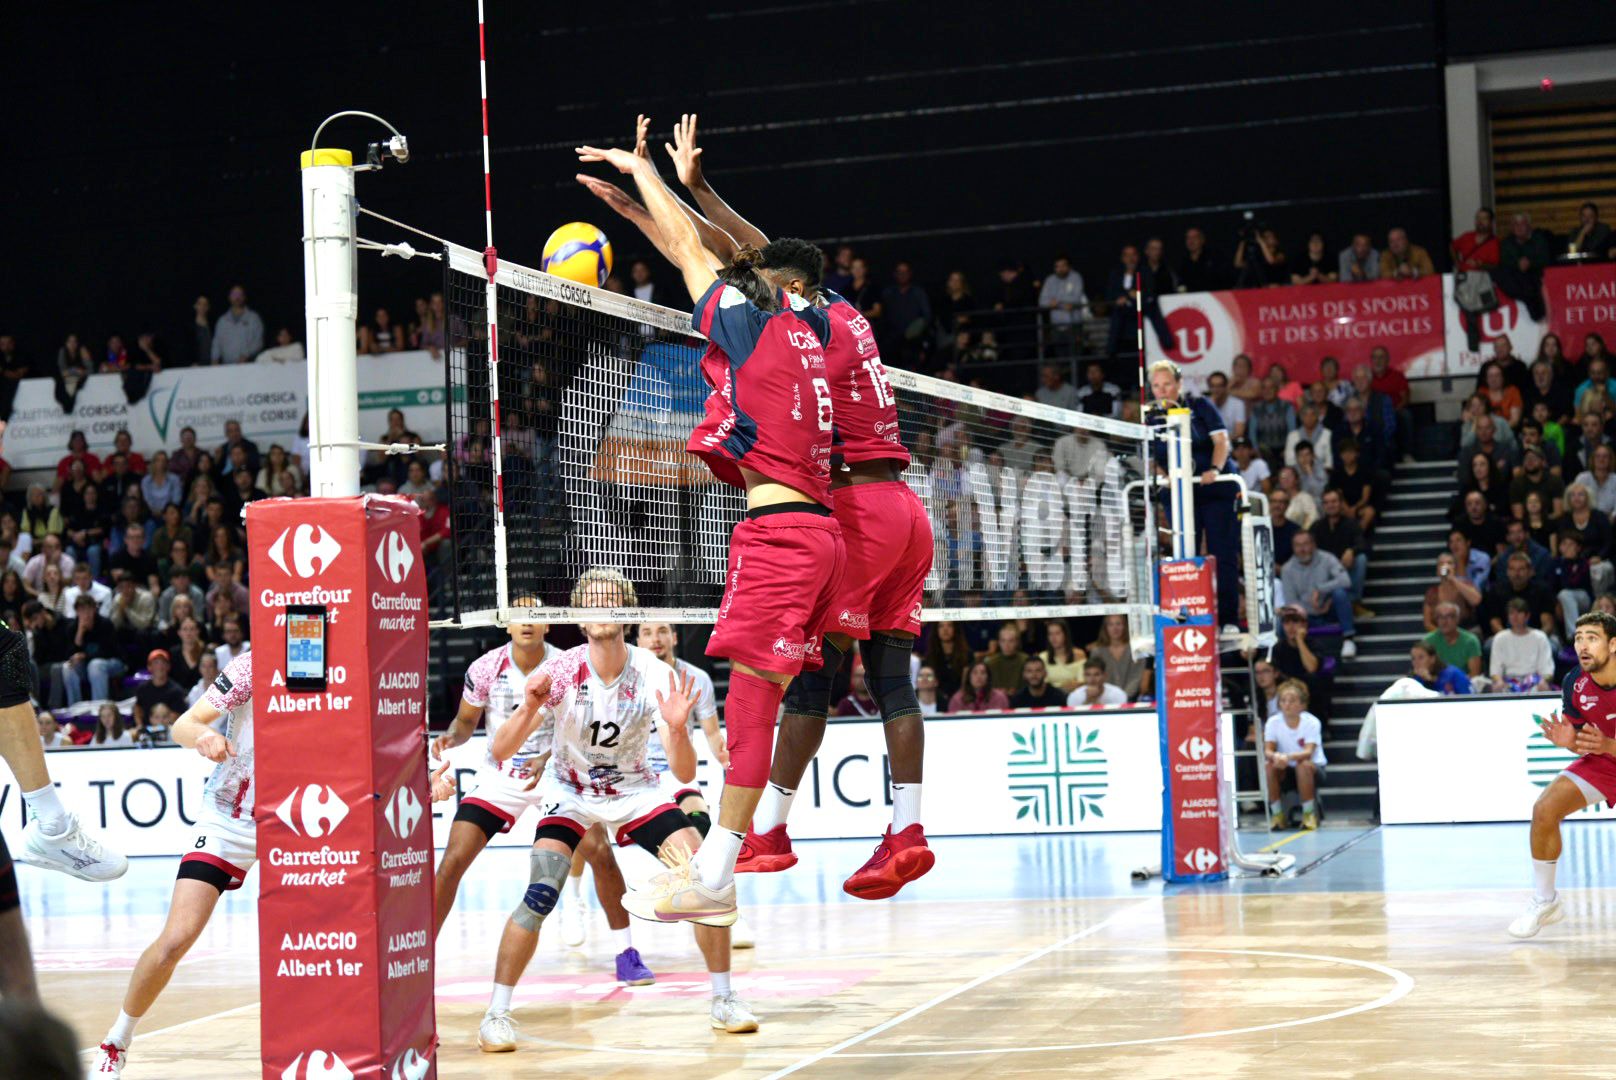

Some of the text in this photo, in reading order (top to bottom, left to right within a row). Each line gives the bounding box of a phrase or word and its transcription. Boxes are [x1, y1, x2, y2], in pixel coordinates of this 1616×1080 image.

[561, 283, 592, 306] CORSICA
[1566, 282, 1616, 300] PALAI
[1258, 294, 1430, 321] PALAIS DES SPORTS
[1566, 304, 1616, 324] ET DE
[1258, 317, 1432, 345] ET DES SPECTACLES
[246, 389, 296, 406] CORSICA
[79, 403, 128, 418] CORSICA
[261, 408, 298, 422] CORSE
[260, 585, 352, 607] Carrefour
[372, 592, 421, 611] Carrefour
[379, 614, 417, 632] market
[1170, 655, 1212, 664] Carrefour
[379, 672, 419, 689] AJACCIO
[1175, 687, 1211, 697] AJACCIO
[267, 693, 352, 713] Albert 1er
[378, 696, 421, 715] Albert 1er
[1174, 698, 1198, 708] Albert
[590, 720, 620, 748] 12
[269, 846, 360, 866] Carrefour
[381, 847, 428, 869] Carrefour
[281, 868, 347, 888] market
[390, 868, 421, 888] market
[281, 932, 357, 951] AJACCIO
[388, 930, 426, 953] AJACCIO
[277, 958, 363, 977] Albert 1er
[388, 957, 429, 980] Albert 1er
